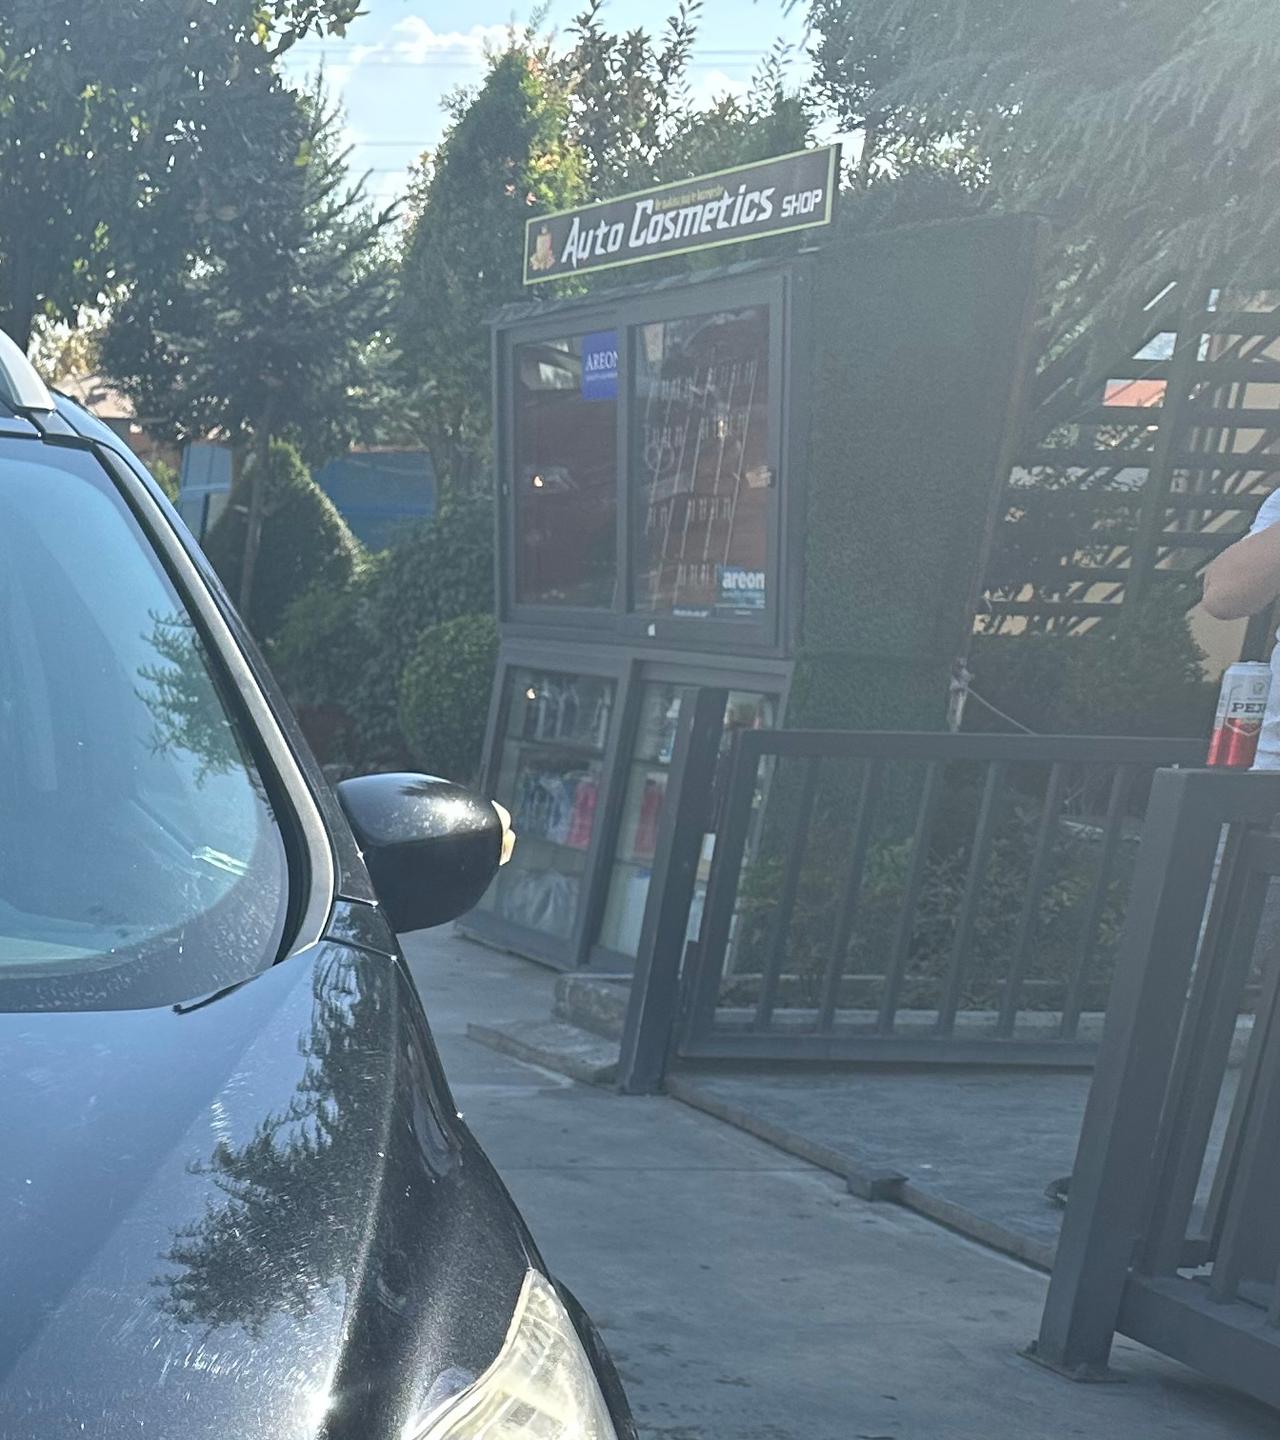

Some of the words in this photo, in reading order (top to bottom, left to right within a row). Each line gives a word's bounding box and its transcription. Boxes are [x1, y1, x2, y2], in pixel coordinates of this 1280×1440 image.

[560, 216, 625, 268] Auto
[628, 183, 776, 249] Cosmetics
[780, 188, 823, 219] SHOP
[722, 571, 766, 590] areon
